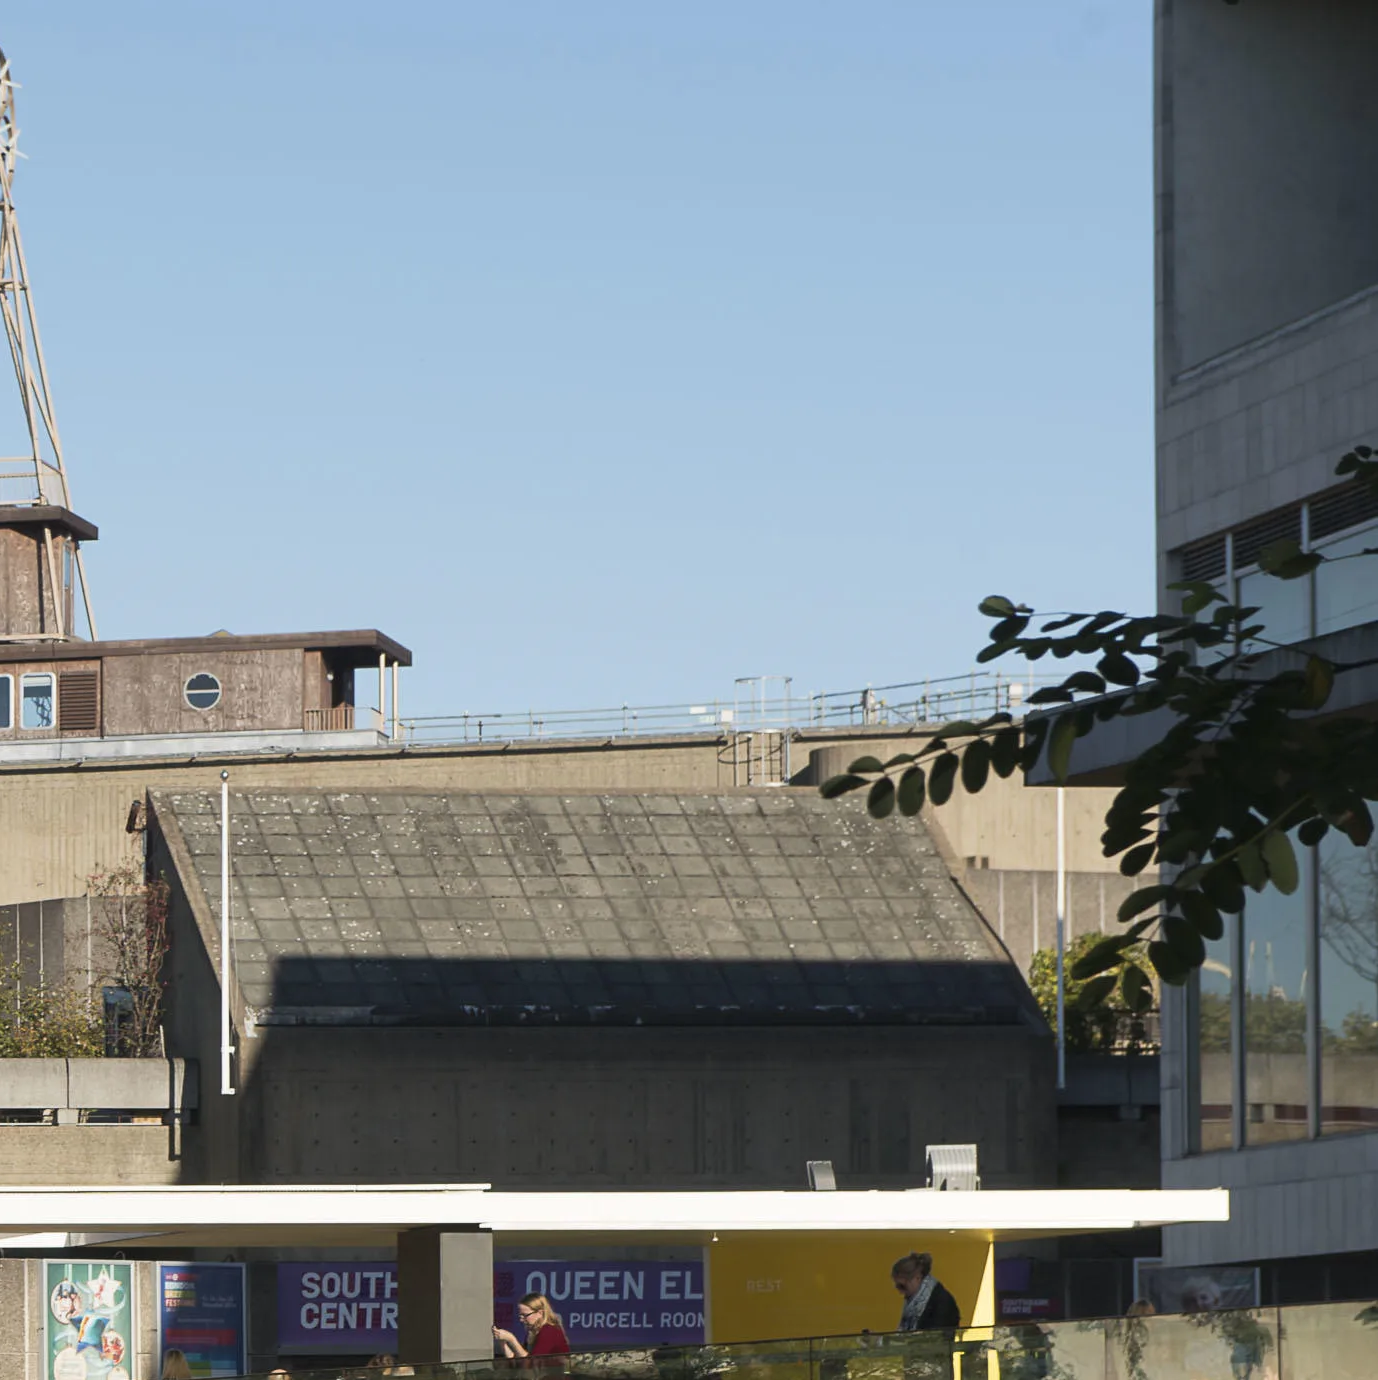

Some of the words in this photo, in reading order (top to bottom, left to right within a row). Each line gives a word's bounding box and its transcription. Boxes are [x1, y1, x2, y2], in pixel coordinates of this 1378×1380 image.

[526, 1271, 644, 1300] QUEEN
[660, 1270, 704, 1300] EL
[569, 1312, 653, 1329] PURCELL
